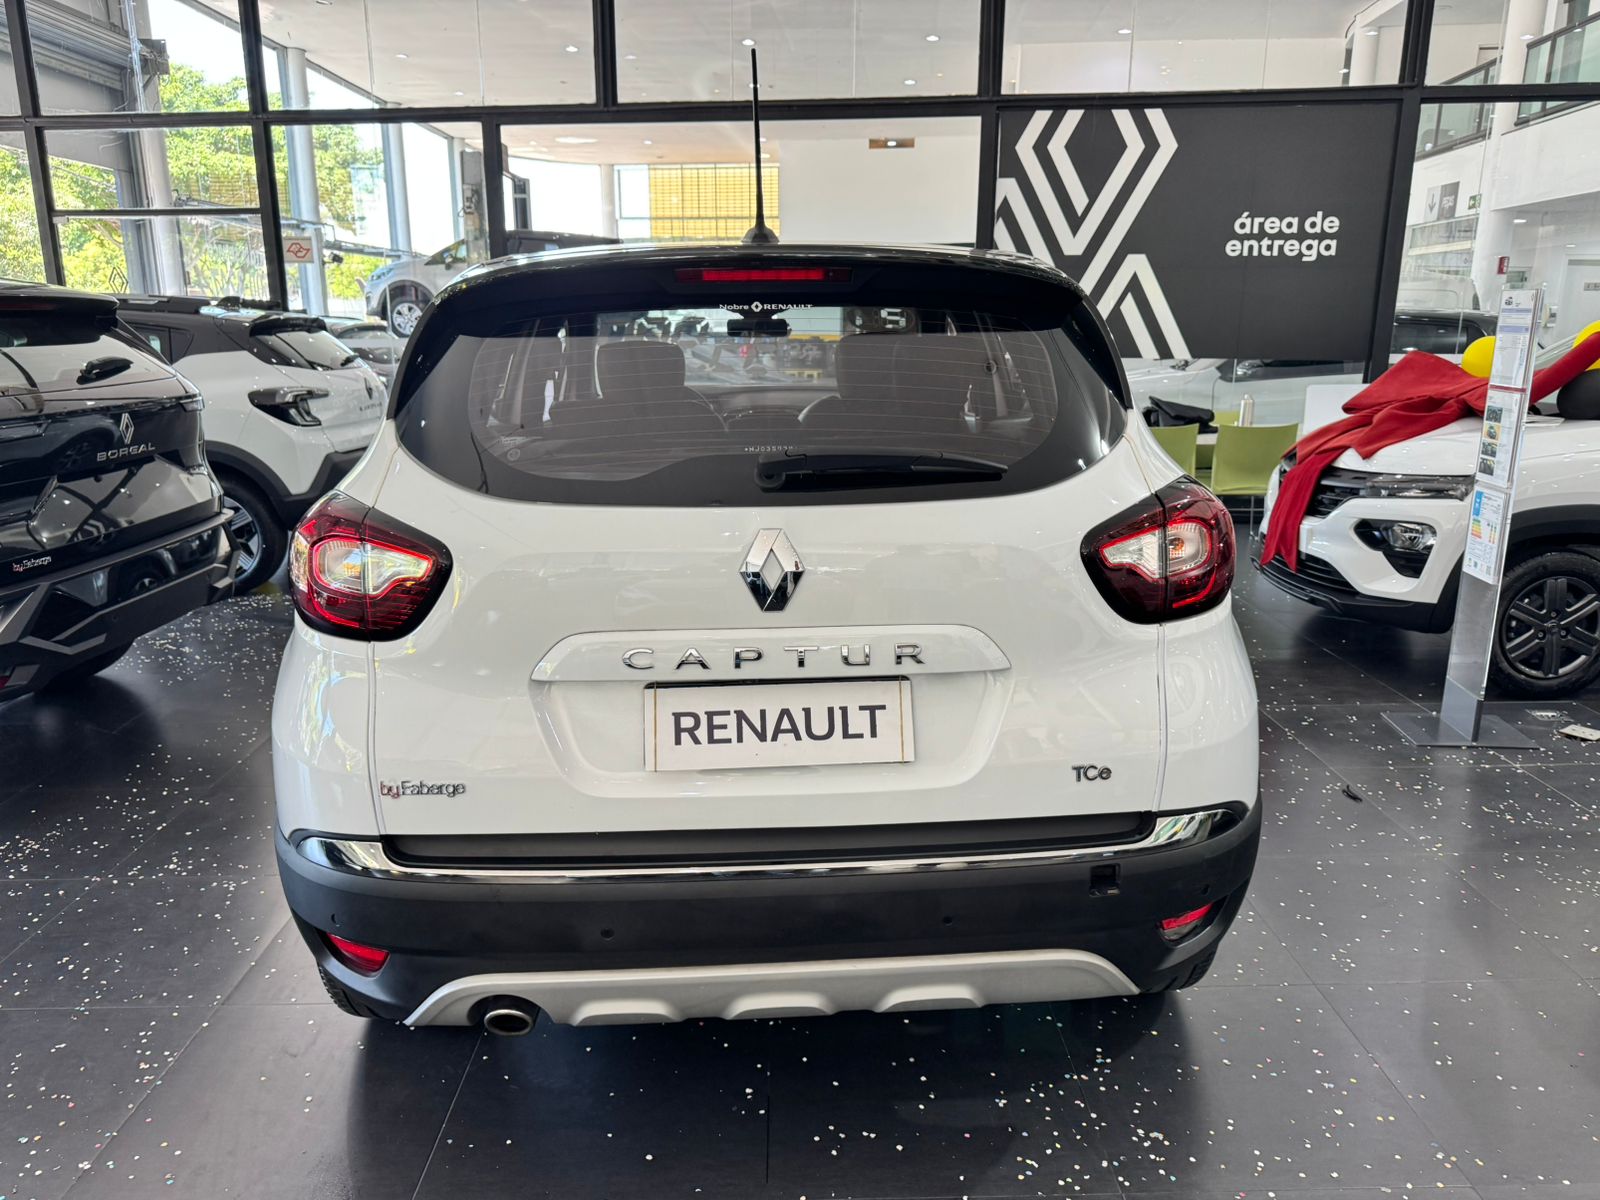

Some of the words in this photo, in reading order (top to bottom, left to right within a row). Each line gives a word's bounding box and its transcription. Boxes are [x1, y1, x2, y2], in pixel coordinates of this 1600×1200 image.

[1234, 211, 1299, 235] área
[1304, 210, 1341, 234] de
[1224, 237, 1338, 262] entrega
[718, 303, 749, 311] Nobre
[763, 303, 813, 311] RENAULT
[97, 442, 156, 462] BOREAL
[622, 642, 925, 670] CAPTUR
[671, 704, 887, 746] RENAULT
[1071, 763, 1112, 782] TCe
